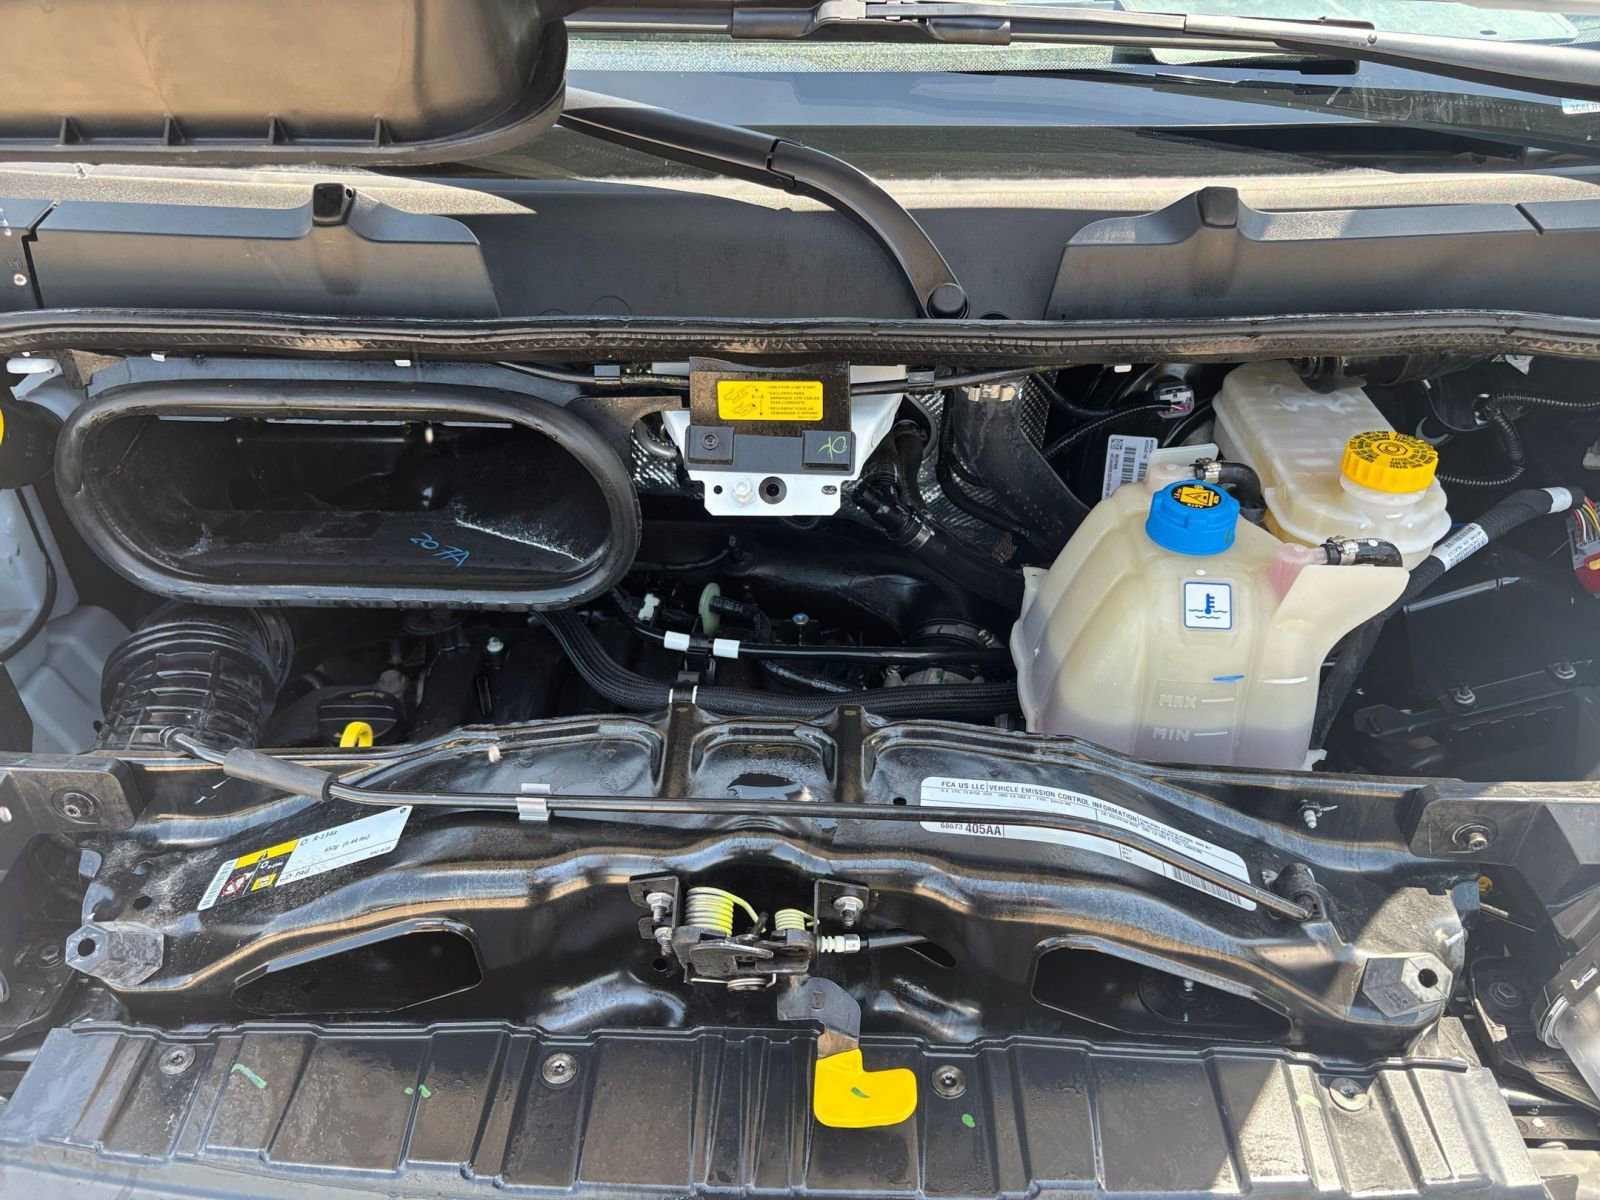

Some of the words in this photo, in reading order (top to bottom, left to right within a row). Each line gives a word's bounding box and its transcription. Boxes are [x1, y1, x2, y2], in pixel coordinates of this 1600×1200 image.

[1160, 694, 1197, 709] MAX
[1152, 727, 1190, 742] MIN
[989, 784, 1018, 793] VEHICLE
[1021, 787, 1056, 798] EMISSION
[1058, 792, 1090, 806] CONTROL
[1092, 801, 1138, 821] INFORMATION
[965, 823, 1002, 836] 405AA
